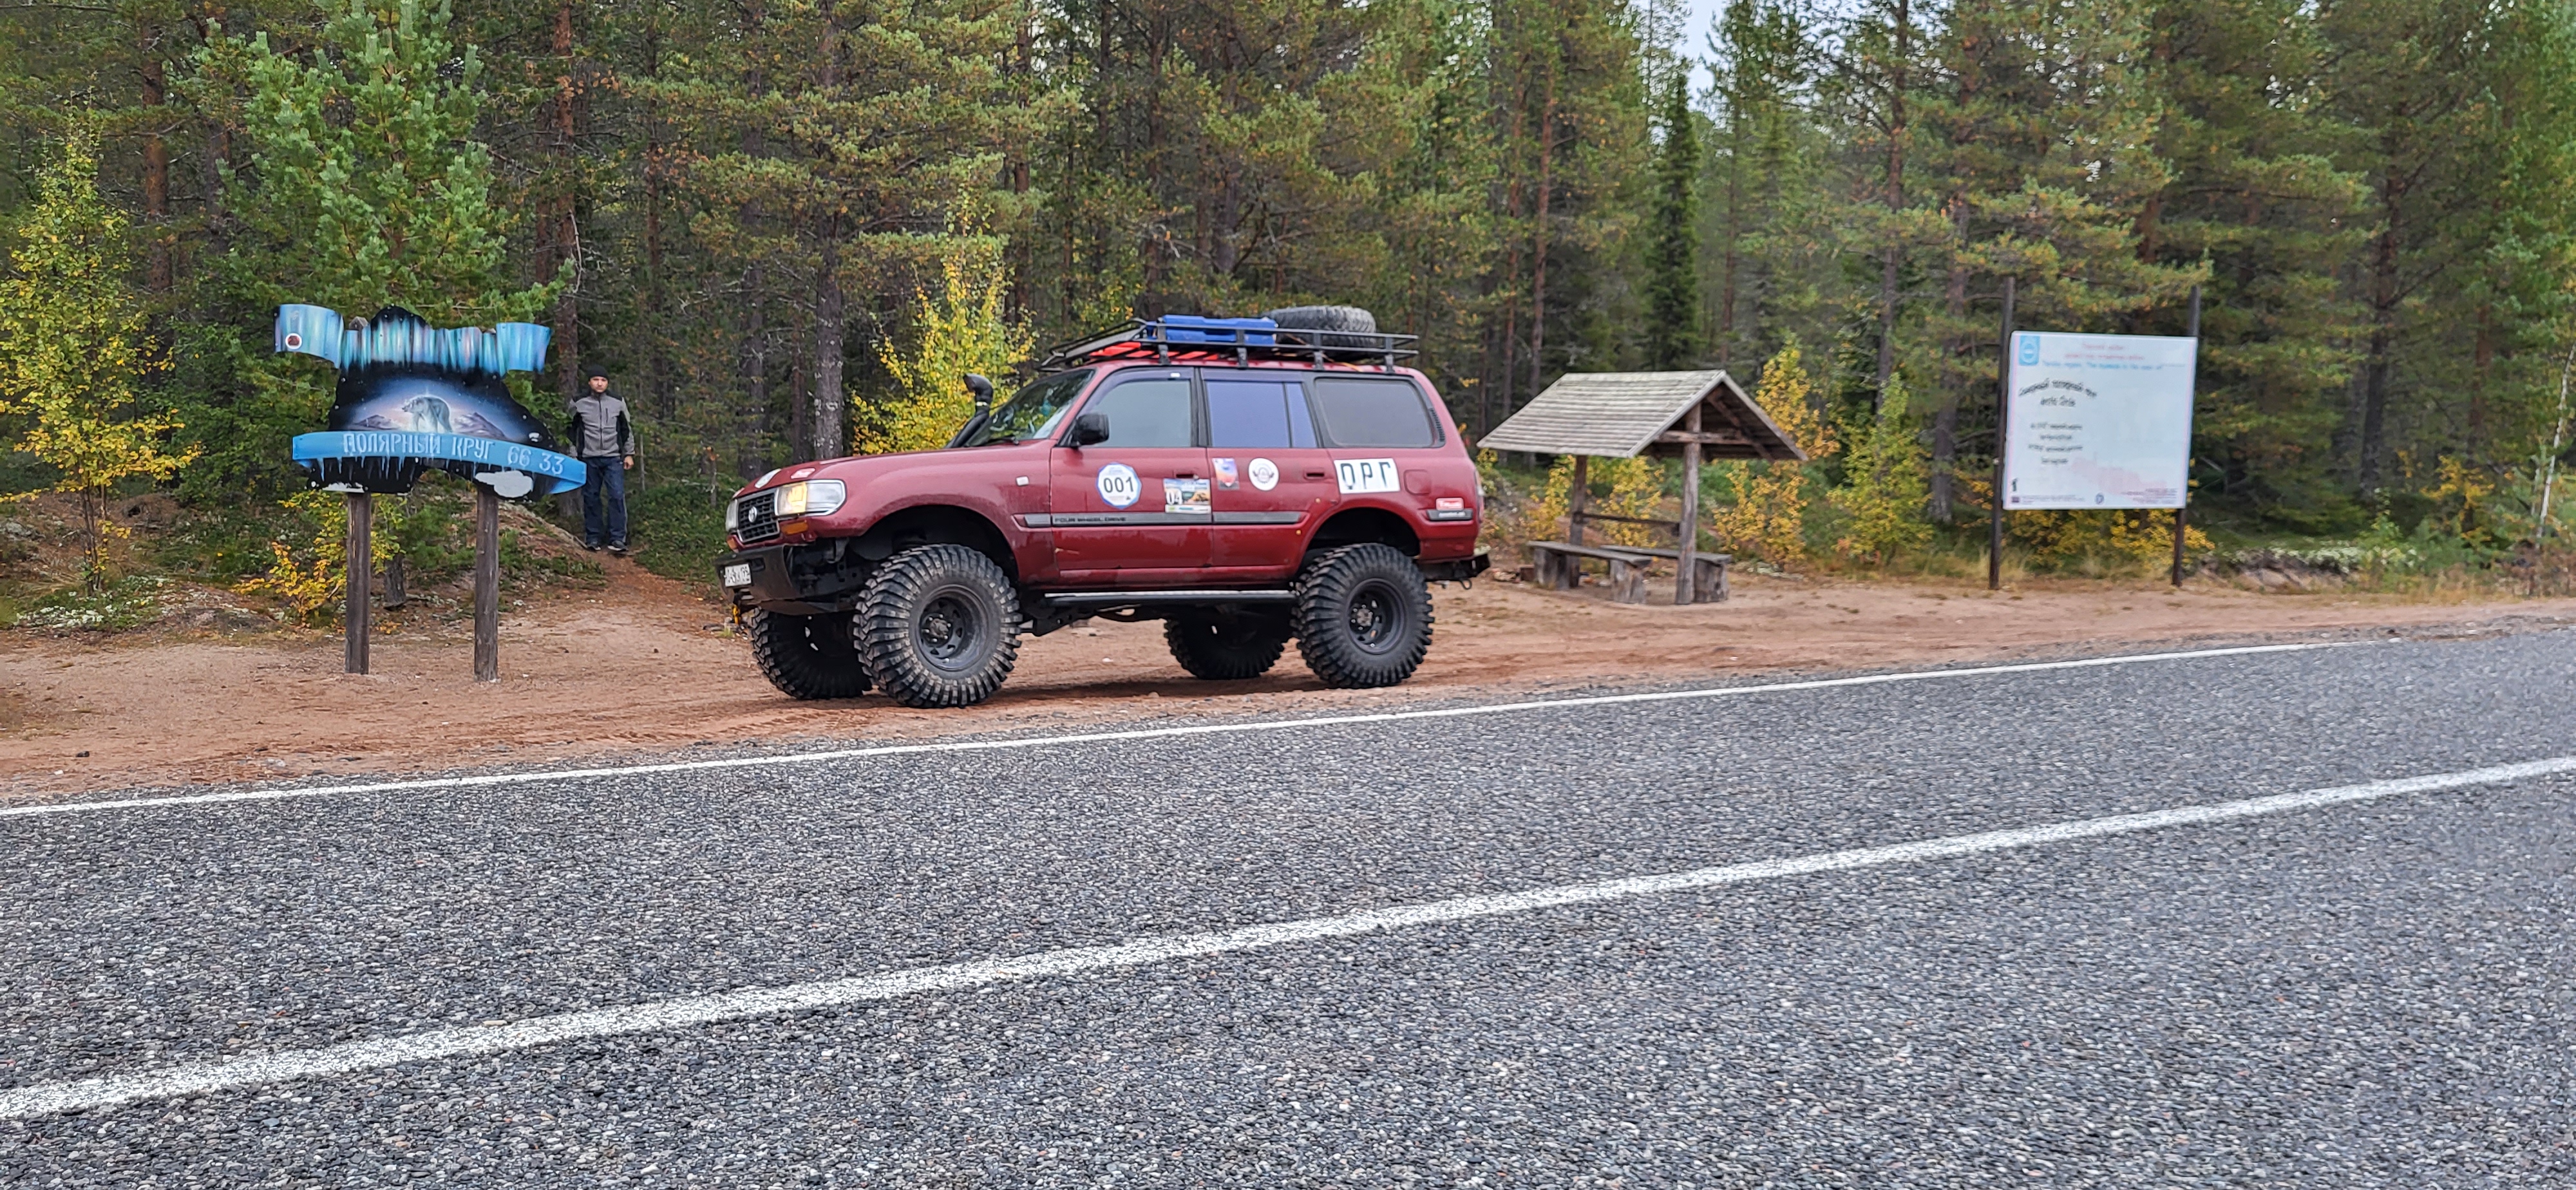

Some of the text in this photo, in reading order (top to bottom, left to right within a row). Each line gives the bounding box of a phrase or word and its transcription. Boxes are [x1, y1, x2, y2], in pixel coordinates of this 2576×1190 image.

[343, 432, 565, 475] ПОЛЯРНЫЙ КРУГ 66 33
[1103, 477, 1134, 493] 001
